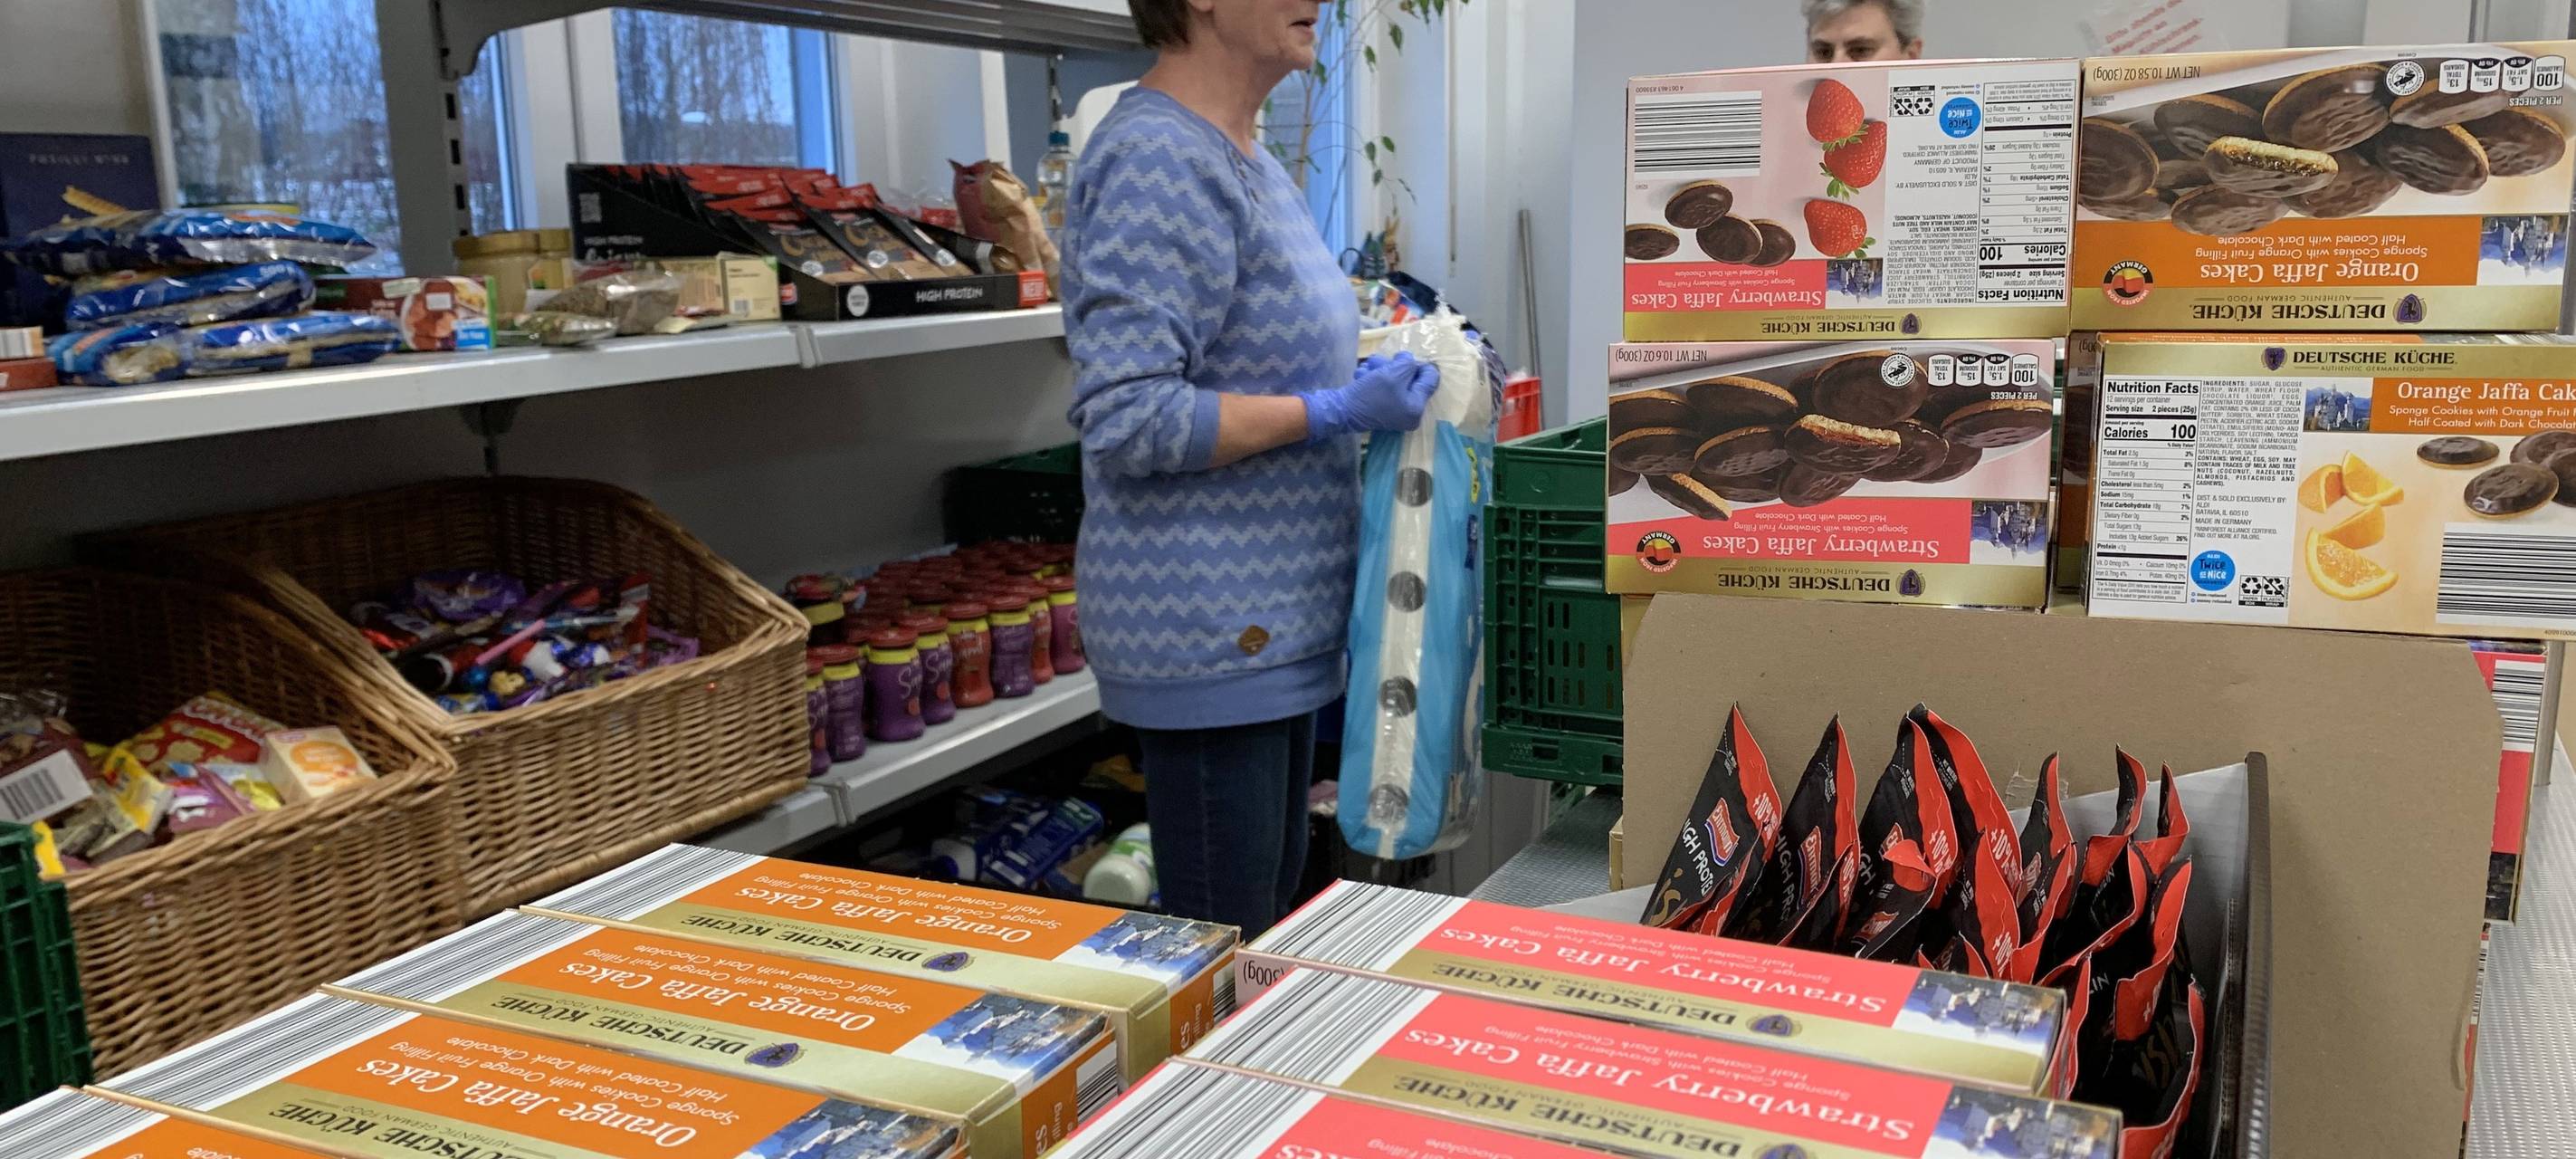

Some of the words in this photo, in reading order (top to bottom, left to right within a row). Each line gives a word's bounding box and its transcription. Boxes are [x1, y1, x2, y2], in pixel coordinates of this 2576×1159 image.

[2093, 66, 2123, 81] (300g)
[2124, 68, 2137, 81] OZ
[2138, 68, 2162, 79] 10.58
[2165, 67, 2180, 79] WT
[2182, 66, 2200, 78] NET
[2536, 72, 2560, 88] 100
[2508, 97, 2538, 107] PIECES
[2539, 97, 2545, 106] 2
[2545, 96, 2563, 106] PER
[2218, 236, 2275, 246] Chocolate
[2279, 235, 2304, 245] Dark
[2308, 235, 2332, 245] with
[2335, 235, 2378, 245] Coated
[2381, 235, 2405, 245] Half
[1979, 246, 2003, 261] 100
[2024, 244, 2066, 257] Calories
[2196, 247, 2228, 260] Filling
[2231, 249, 2255, 259] Fruit
[2258, 246, 2303, 259] Orange
[2306, 249, 2330, 258] with
[2333, 247, 2380, 258] Cookies
[2384, 246, 2428, 258] Sponge
[2110, 262, 2148, 274] GERMANY
[2200, 263, 2264, 283] Cakes
[2272, 263, 2329, 283] Jaffa
[2336, 258, 2419, 282] Orange
[916, 290, 942, 302] HIGH
[943, 287, 984, 300] PROTEIN
[1632, 293, 1678, 307] Cakes
[1684, 292, 1723, 308] Jaffa
[1728, 290, 1823, 306] Strawberry
[1978, 289, 2010, 300] Facts
[2013, 288, 2065, 301] Nutrition
[2190, 305, 2263, 321] KÜCHE
[2272, 304, 2386, 319] DEUTSCHE
[1761, 322, 1811, 335] KÜCHE
[1815, 321, 1896, 333] DEUTSCHE
[1615, 348, 1642, 362] (300g)
[1643, 350, 1655, 362] OZ
[1655, 350, 1673, 362] 10.6
[1675, 350, 1690, 361] WT
[1692, 350, 1707, 361] NET
[2293, 350, 2387, 364] DEUTSCHE
[2394, 350, 2455, 364] KÜCHE
[2014, 370, 2035, 382] 100
[1990, 391, 2017, 400] PIECES
[2018, 391, 2022, 399] 2
[2023, 391, 2037, 400] PER
[2107, 381, 2161, 394] Nutrition
[2164, 382, 2199, 395] Facts
[2398, 381, 2472, 403] Orange
[2478, 382, 2530, 401] Jaffa
[2538, 383, 2576, 401] Cak
[2105, 405, 2130, 413] Serving
[2131, 405, 2144, 413] size
[2157, 405, 2179, 413] pieces
[2390, 405, 2428, 417] Sponge
[2431, 405, 2473, 416] Cookies
[2476, 406, 2498, 416] with
[2502, 407, 2543, 418] Orange
[2547, 407, 2570, 417] Fruit
[2409, 417, 2430, 426] Half
[2432, 417, 2471, 427] Coated
[2475, 417, 2495, 427] with
[2499, 418, 2524, 428] Dark
[2528, 419, 2576, 429] Chocolat
[2104, 426, 2149, 438] Calories
[2171, 424, 2197, 439] 100
[1755, 512, 1796, 522] Chocolate
[1797, 512, 1818, 522] Dark
[1818, 513, 1836, 522] with
[1837, 513, 1868, 522] Coated
[1869, 513, 1887, 522] Half
[1734, 521, 1758, 532] Filling
[1759, 523, 1776, 532] Fruit
[1778, 522, 1821, 534] Strawberry
[1822, 524, 1840, 534] with
[1841, 525, 1875, 535] Cookies
[1877, 524, 1909, 535] Sponge
[1642, 532, 1675, 544] GERMANY
[1703, 536, 1760, 554] Cakes
[1767, 537, 1818, 556] Jaffa
[1824, 535, 1940, 558] Strawberry
[1717, 574, 1780, 591] KÜCHE
[1789, 576, 1891, 592] DEUTSCHE
[752, 875, 796, 893] Filling
[798, 872, 872, 889] Chocolate
[798, 883, 831, 896] Fruit
[835, 888, 893, 905] Orange
[877, 883, 913, 896] Dark
[916, 888, 947, 901] with
[734, 886, 824, 912] Cakes
[897, 898, 929, 913] with
[949, 895, 1007, 910] Coated
[830, 901, 912, 924] Jaffa
[933, 903, 996, 921] Cookies
[1011, 904, 1045, 917] Half
[681, 915, 773, 937] KÜCHE
[914, 915, 1032, 943] Orange
[1002, 913, 1062, 931] Sponge
[775, 931, 923, 962] DEUTSCHE
[1440, 926, 1541, 956] Cakes
[583, 948, 627, 967] Filling
[633, 943, 711, 964] Chocolate
[1546, 945, 1650, 975] Jaffa
[629, 957, 664, 972] Fruit
[715, 958, 753, 972] Dark
[558, 962, 653, 990] Cakes
[668, 963, 730, 982] Orange
[756, 965, 788, 980] with
[1432, 963, 1541, 993] KÜCHE
[733, 975, 768, 991] with
[795, 972, 854, 989] Coated
[659, 978, 747, 1008] Jaffa
[773, 982, 839, 1002] Cookies
[856, 982, 897, 998] Half
[1660, 963, 1888, 1014] Strawberry
[491, 995, 592, 1023] KÜCHE
[844, 994, 911, 1015] Sponge
[1551, 982, 1738, 1027] DEUTSCHE
[748, 996, 875, 1032] Orange
[589, 1016, 749, 1055] DEUTSCHE
[1402, 1028, 1521, 1066] Cakes
[354, 1058, 459, 1095] Cakes
[1534, 1051, 1643, 1087] Jaffa
[463, 1080, 560, 1116] Jaffa
[1392, 1075, 1518, 1113] KÜCHE
[1651, 1074, 1915, 1142] Strawberry
[268, 1104, 379, 1135] KÜCHE
[557, 1102, 697, 1148] Orange
[1529, 1104, 1744, 1159] DEUTSCHE
[373, 1127, 534, 1159] UTSCHE
